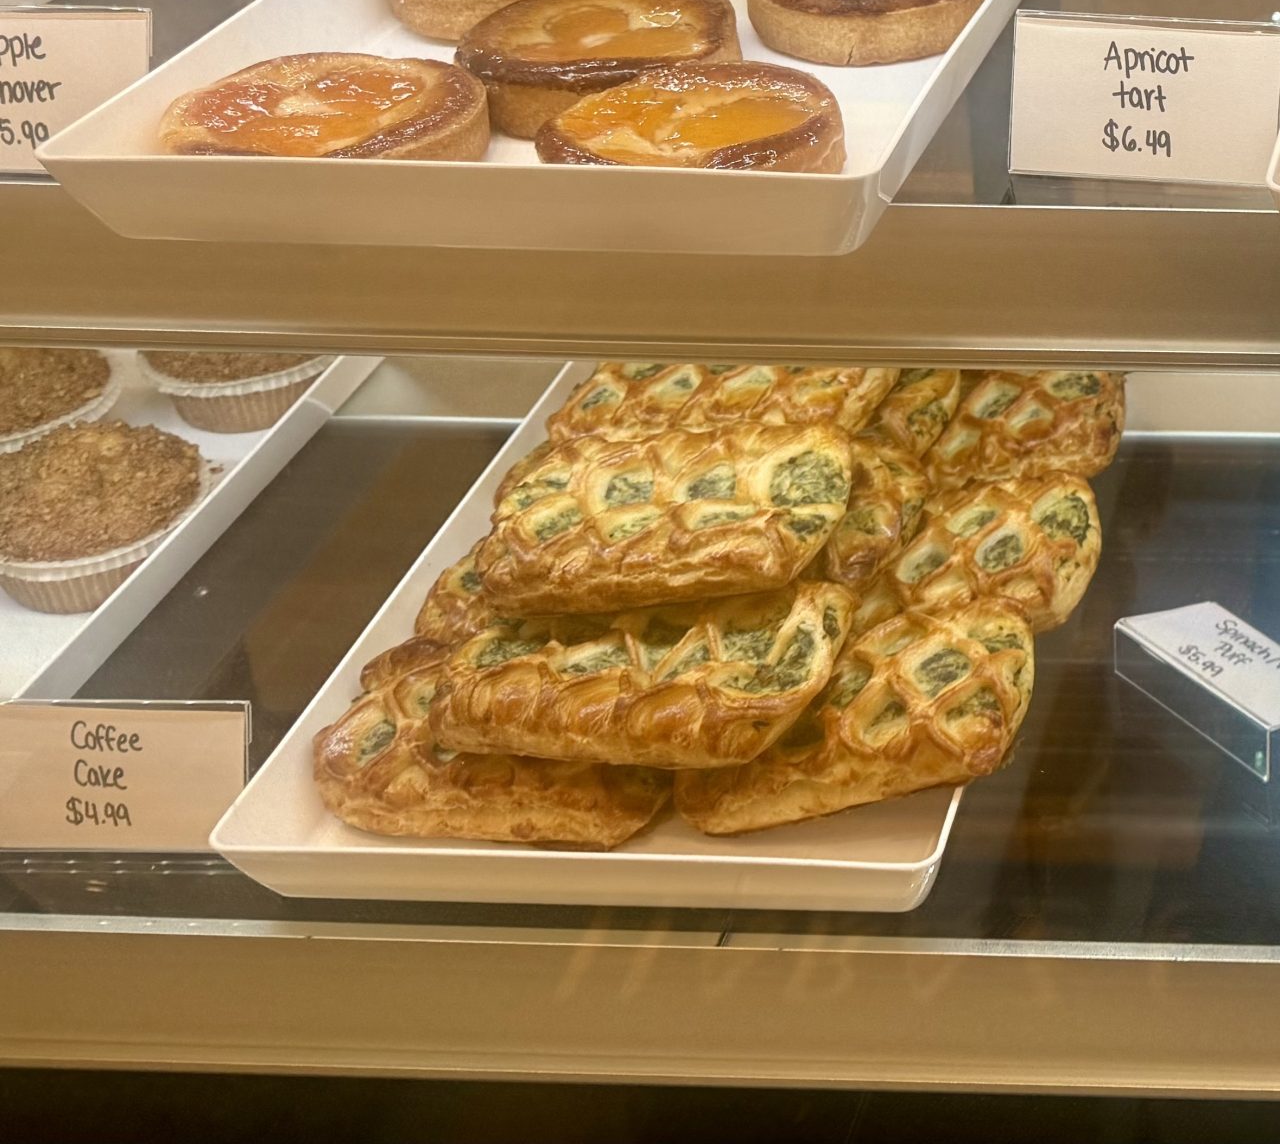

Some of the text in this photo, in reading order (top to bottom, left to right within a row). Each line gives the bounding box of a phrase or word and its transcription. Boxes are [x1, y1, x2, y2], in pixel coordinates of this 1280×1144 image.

[1104, 41, 1195, 78] Apricot
[1112, 81, 1167, 112] tart
[1102, 119, 1171, 157] $6.49
[1178, 644, 1224, 678] $5.99
[71, 720, 143, 753] Coffee
[74, 759, 128, 790] Cake
[66, 797, 132, 827] $4.99
